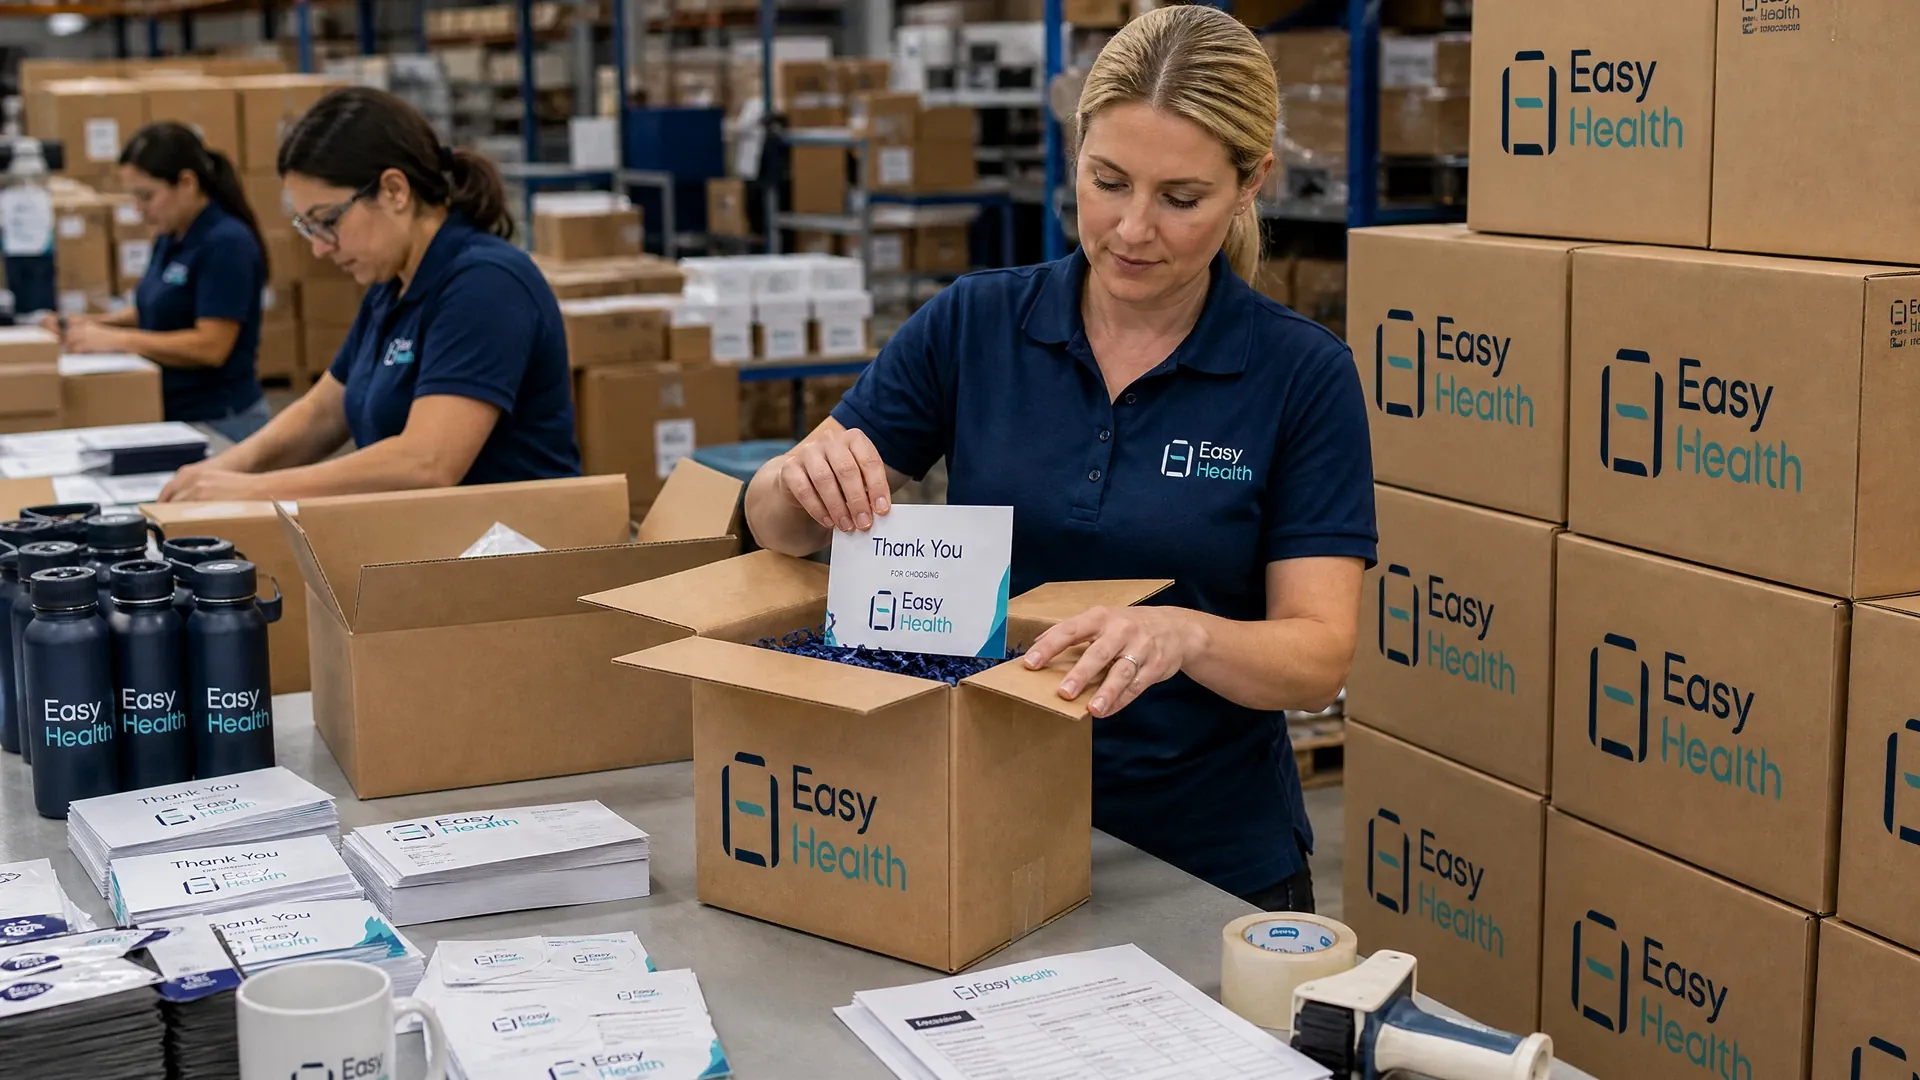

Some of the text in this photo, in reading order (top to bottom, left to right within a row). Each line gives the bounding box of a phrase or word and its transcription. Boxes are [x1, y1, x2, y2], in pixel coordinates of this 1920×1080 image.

[1571, 49, 1657, 103] Easy
[1570, 105, 1683, 149] Health
[1437, 316, 1511, 378] Easy
[1436, 372, 1534, 428] Health
[1678, 357, 1774, 432] Easy
[1199, 441, 1243, 464] Easy
[1676, 424, 1802, 493] Health
[1196, 461, 1252, 481] Health
[872, 537, 963, 559] Thank You
[905, 570, 939, 579] CHOOSING
[902, 591, 943, 615] Easy
[1428, 574, 1494, 641] Easy
[900, 614, 952, 633] Health
[1427, 629, 1515, 695] Health
[122, 688, 176, 711] Easy
[207, 687, 260, 711] Easy
[1663, 651, 1755, 735] Easy
[44, 699, 101, 724] Easy
[123, 710, 186, 735] Health
[208, 708, 269, 734] Health
[45, 721, 112, 747] Health
[1662, 715, 1781, 802] Health
[137, 789, 200, 805] Thank
[204, 783, 240, 793] You
[193, 797, 237, 811] Easy
[793, 765, 878, 835] Easy
[200, 801, 257, 818] Health
[435, 814, 494, 827] Easy
[442, 819, 519, 834] Health
[170, 856, 237, 869] Thank
[241, 851, 279, 861] You
[793, 822, 906, 891] Health
[1420, 828, 1484, 901] Easy
[222, 868, 269, 881] Easy
[225, 872, 287, 888] Health
[272, 912, 311, 921] You
[1418, 880, 1503, 959] Health
[250, 931, 299, 943] Easy
[253, 936, 318, 952] Health
[973, 968, 1058, 993] Easy Health
[1642, 936, 1728, 1024] Easy
[518, 1012, 549, 1022] Easy
[1640, 995, 1752, 1080] Health
[342, 1052, 384, 1080] Easy
[592, 1051, 644, 1067] Easy
[598, 1059, 665, 1080] Health
